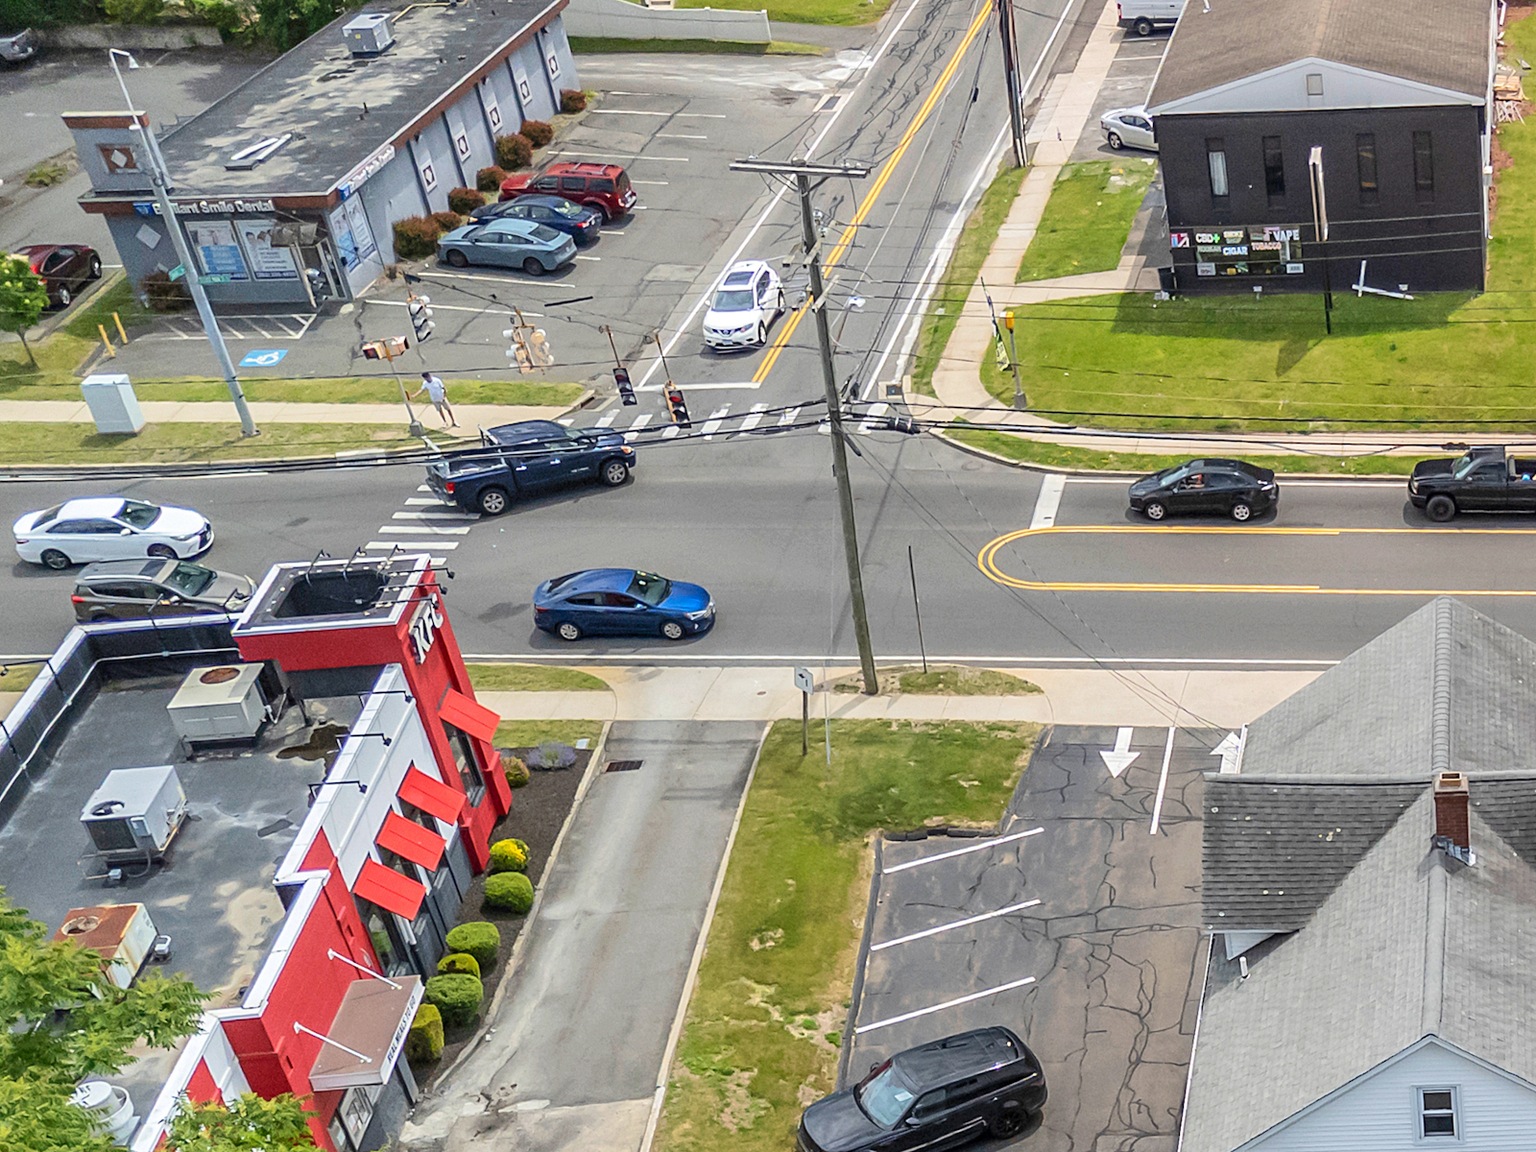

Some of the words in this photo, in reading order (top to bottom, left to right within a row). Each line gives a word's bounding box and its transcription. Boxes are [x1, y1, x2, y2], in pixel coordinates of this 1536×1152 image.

[200, 200, 235, 213] Smile
[234, 200, 275, 213] Dental
[1273, 229, 1300, 241] VAPE
[1222, 246, 1249, 256] CIGAR
[1251, 241, 1282, 251] TOBACCO
[411, 593, 443, 665] KFC
[395, 1018, 407, 1043] MEALS
